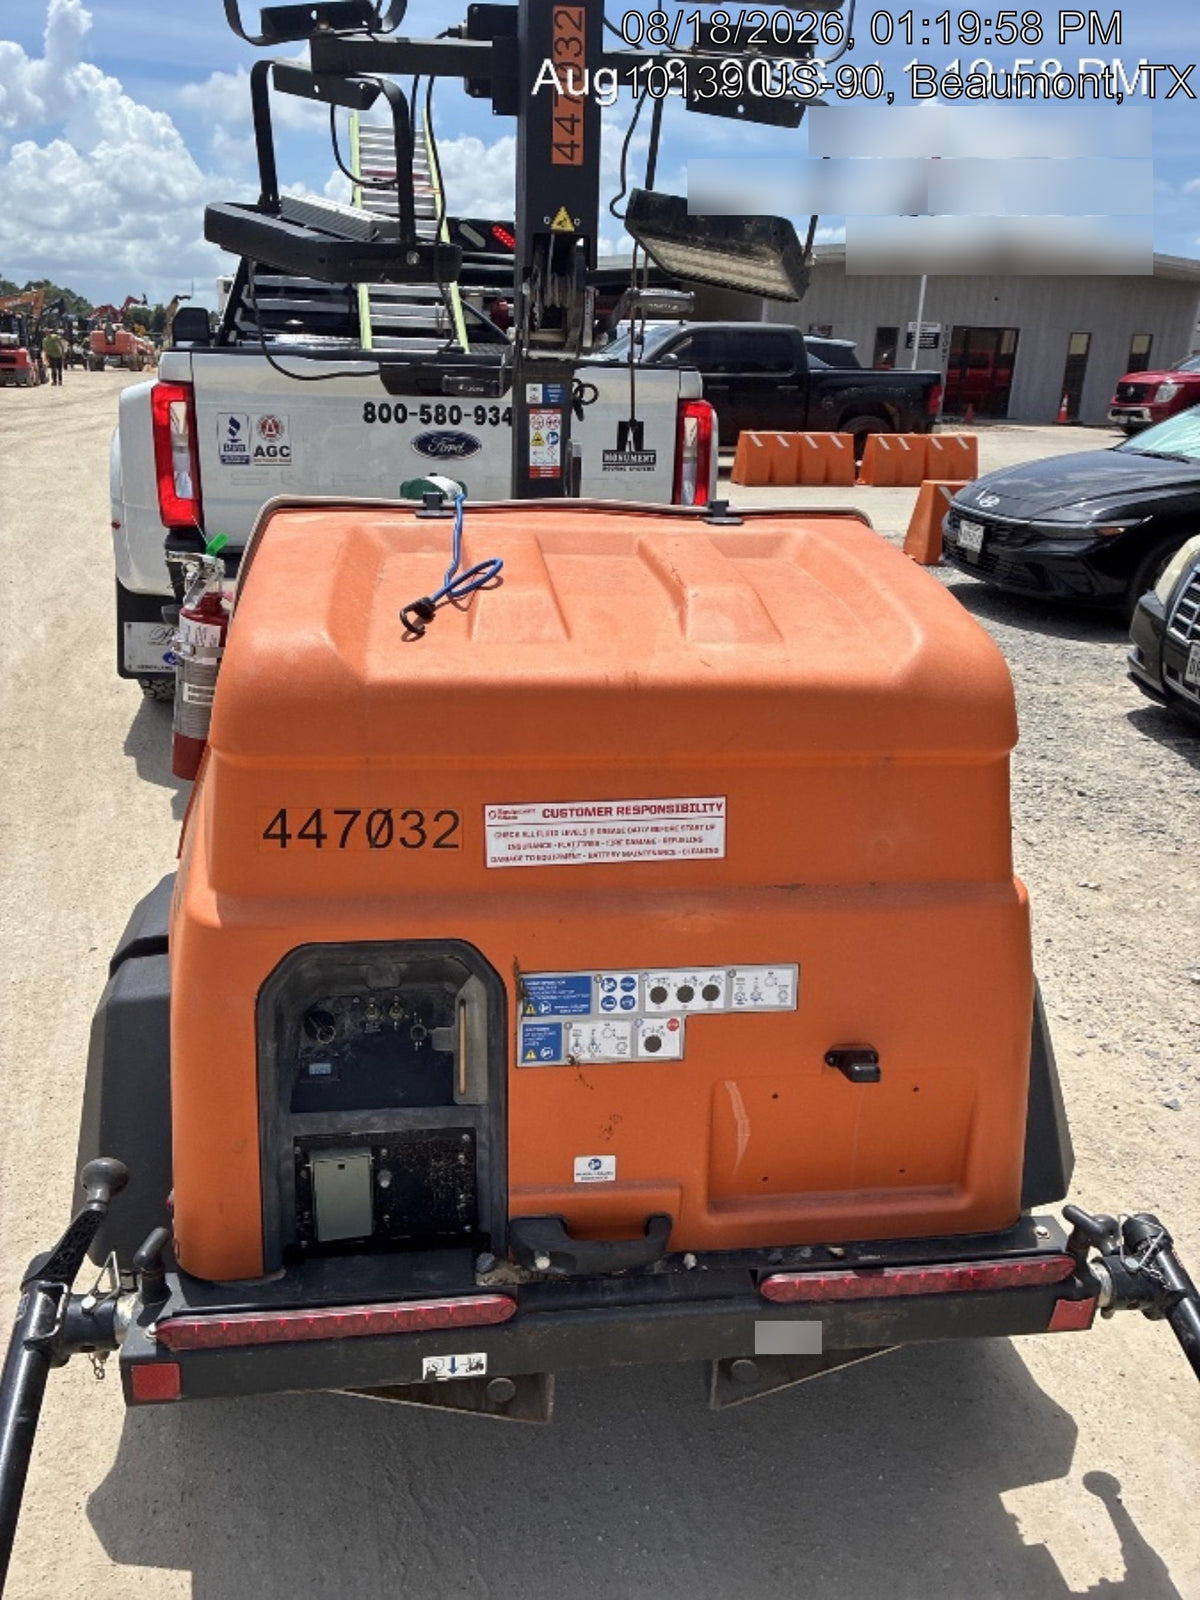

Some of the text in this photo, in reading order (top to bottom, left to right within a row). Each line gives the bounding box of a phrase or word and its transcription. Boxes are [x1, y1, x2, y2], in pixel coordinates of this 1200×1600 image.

[253, 445, 291, 458] AGC
[427, 436, 466, 454] Ford
[603, 453, 656, 463] MONUMENT
[541, 806, 613, 819] CUSTOMER
[616, 803, 724, 816] RESPONSIBILITY
